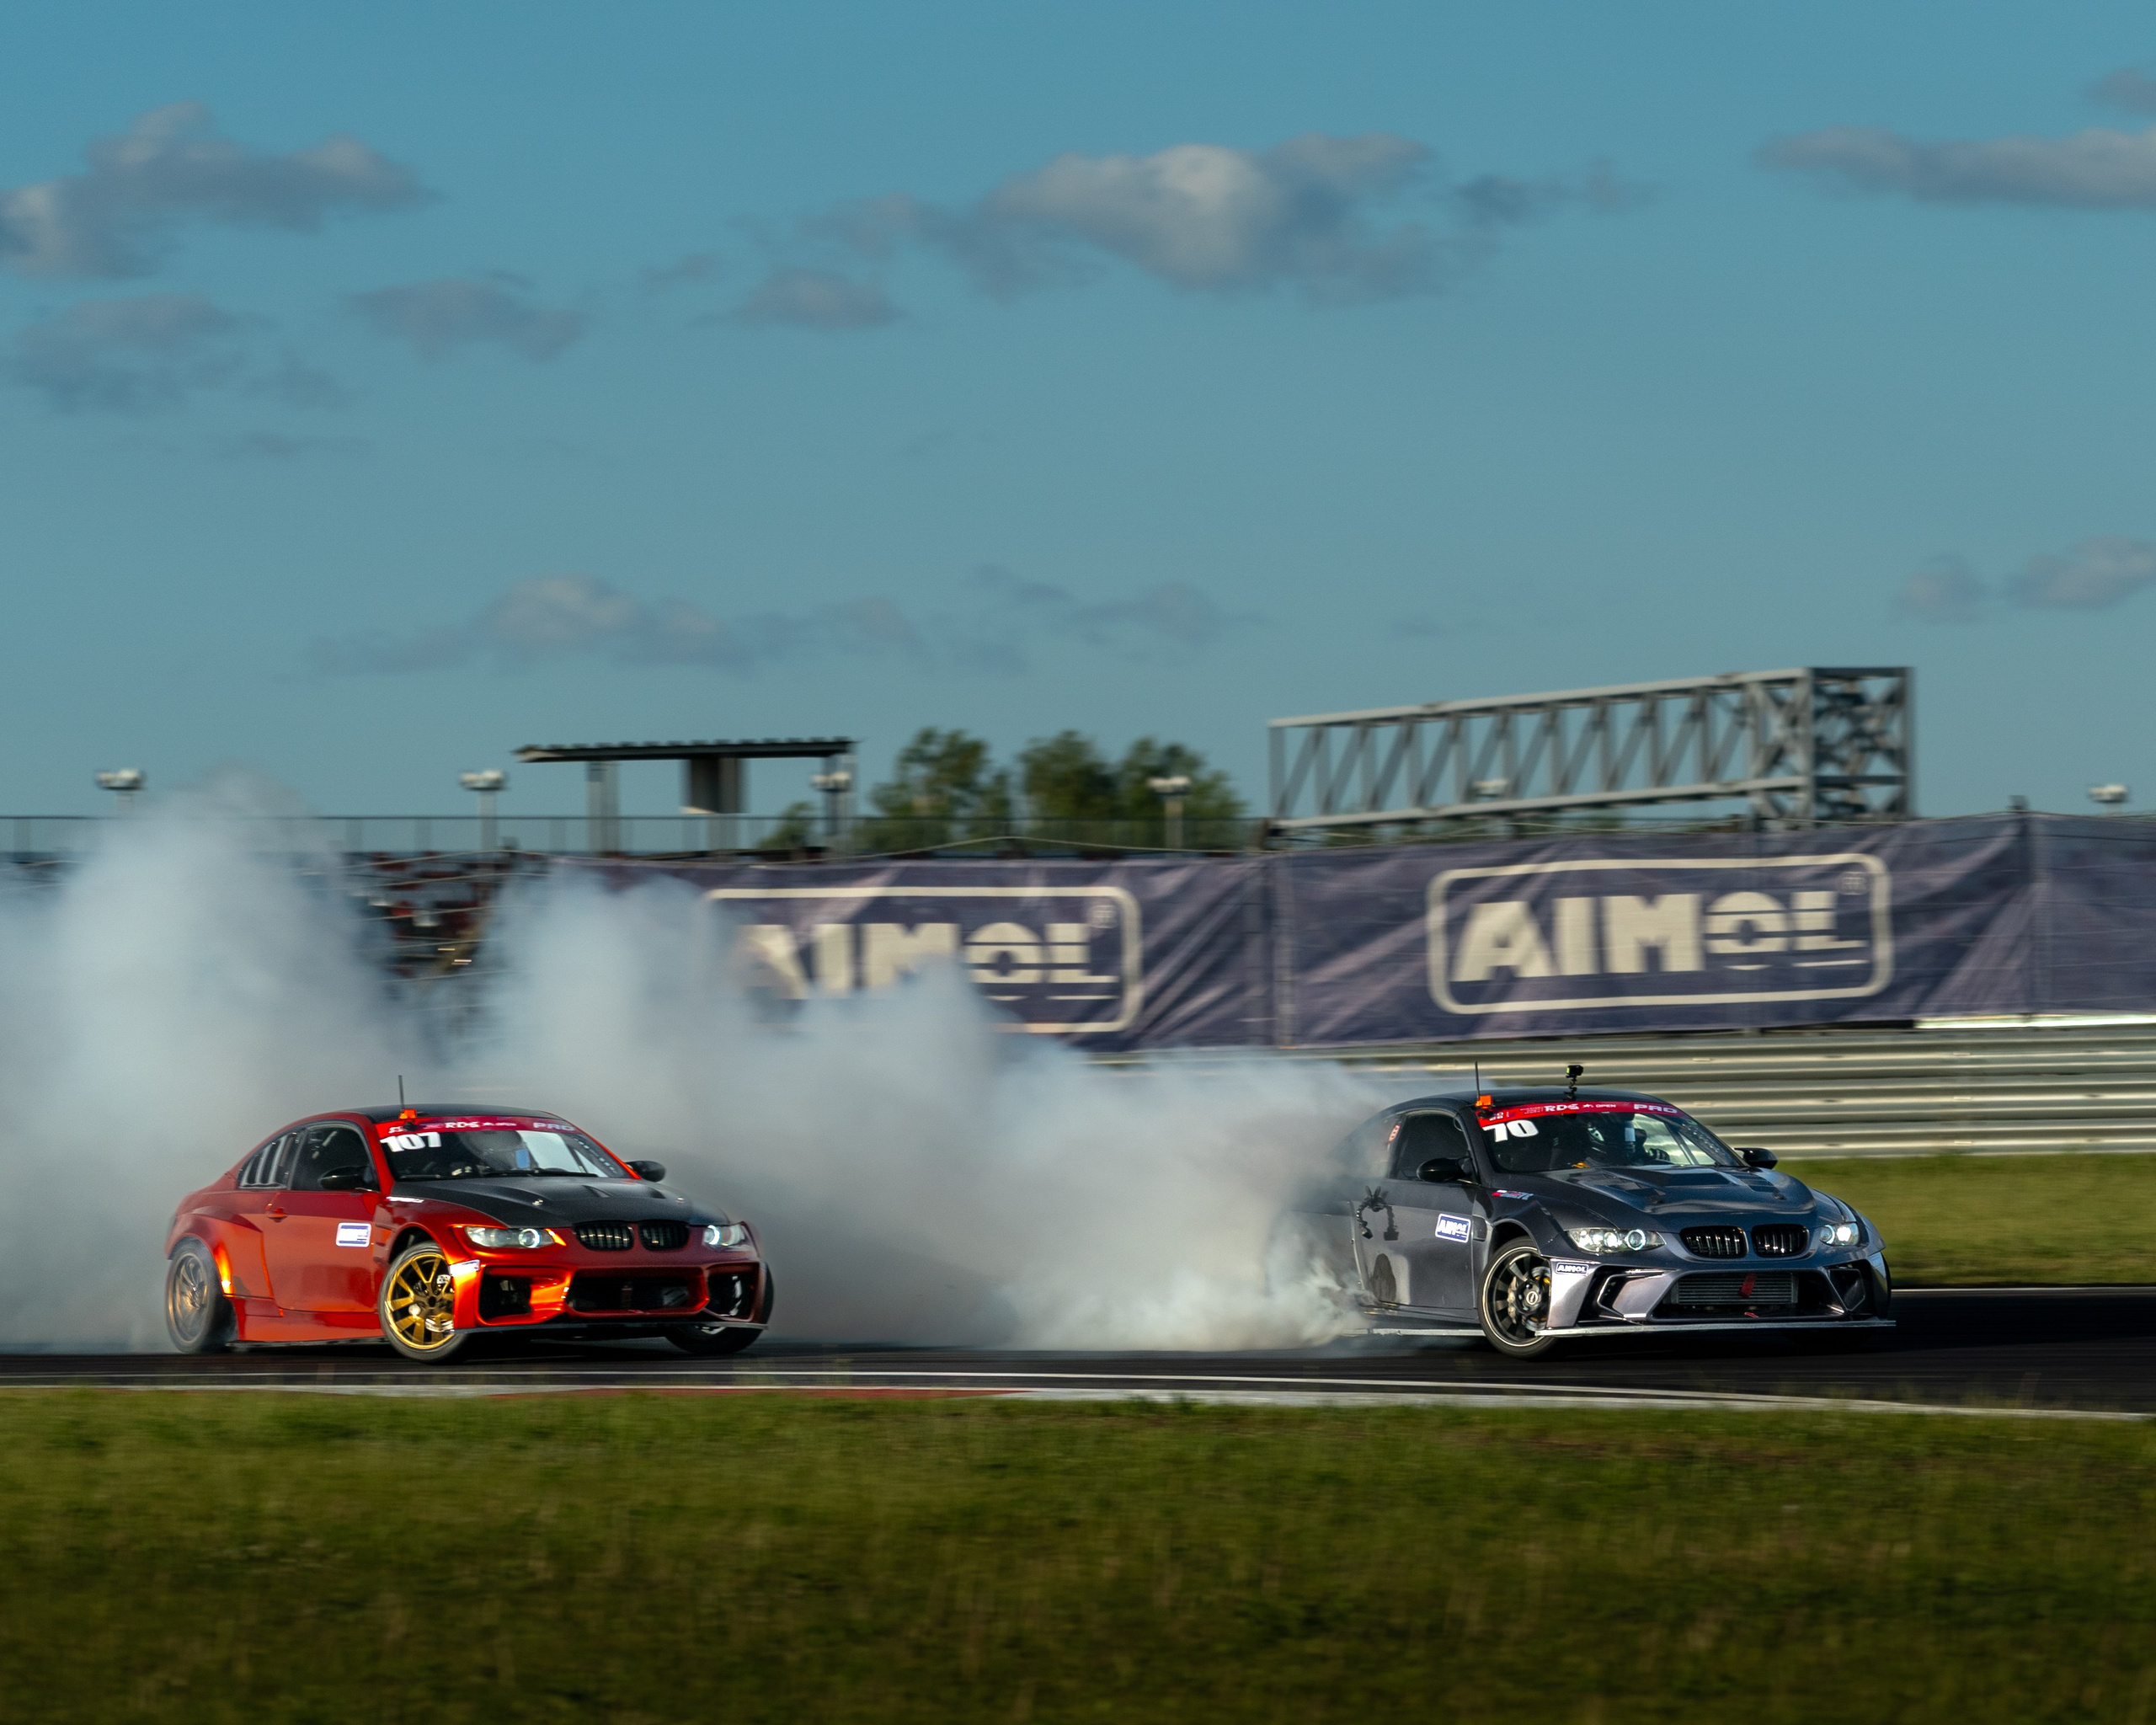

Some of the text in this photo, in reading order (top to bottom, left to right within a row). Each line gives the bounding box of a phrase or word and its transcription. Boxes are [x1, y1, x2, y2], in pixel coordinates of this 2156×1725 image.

[1449, 890, 1870, 982] AIMOL
[1544, 1103, 1580, 1113] RDS
[1633, 1103, 1678, 1114] PRO
[532, 1122, 575, 1131] PRO
[1481, 1119, 1540, 1143] 70
[379, 1131, 442, 1153] 107
